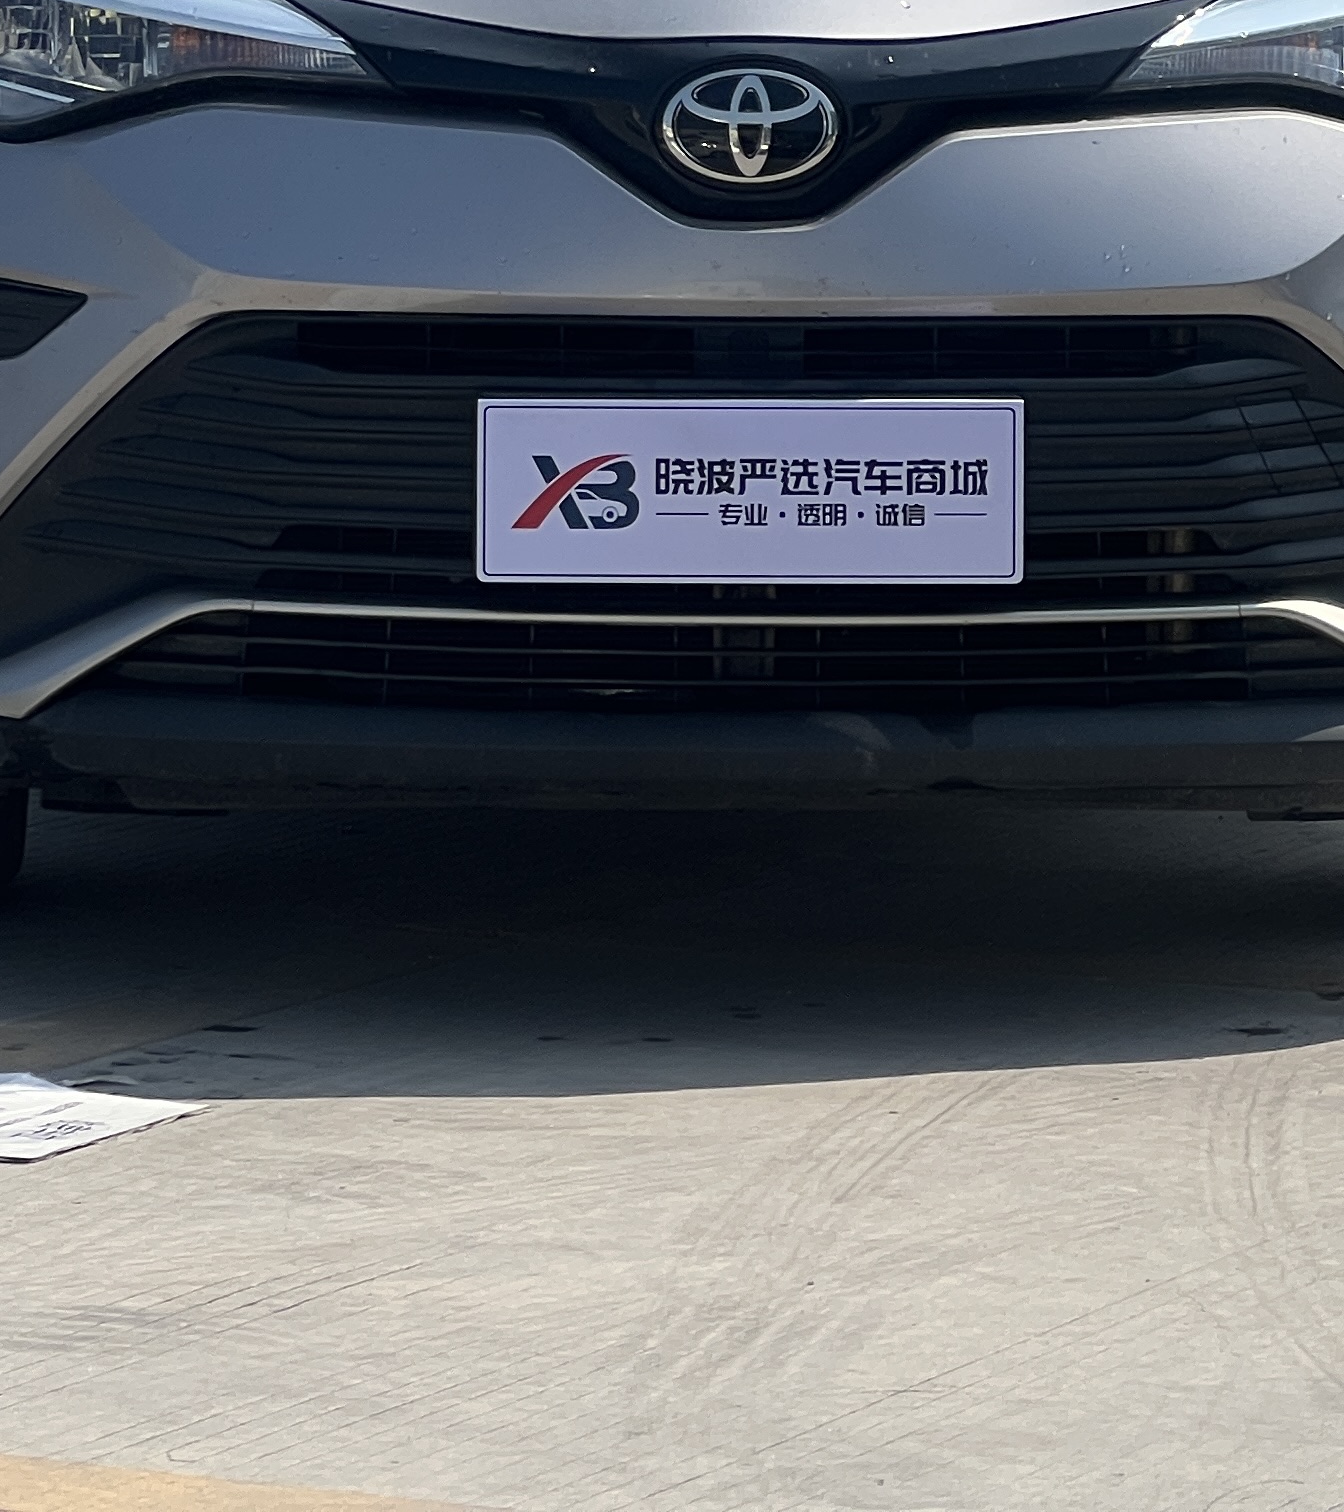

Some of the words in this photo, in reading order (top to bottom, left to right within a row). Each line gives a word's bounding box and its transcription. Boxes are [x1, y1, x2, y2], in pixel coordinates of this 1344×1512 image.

[655, 458, 989, 497] 晓波严选汽车商城
